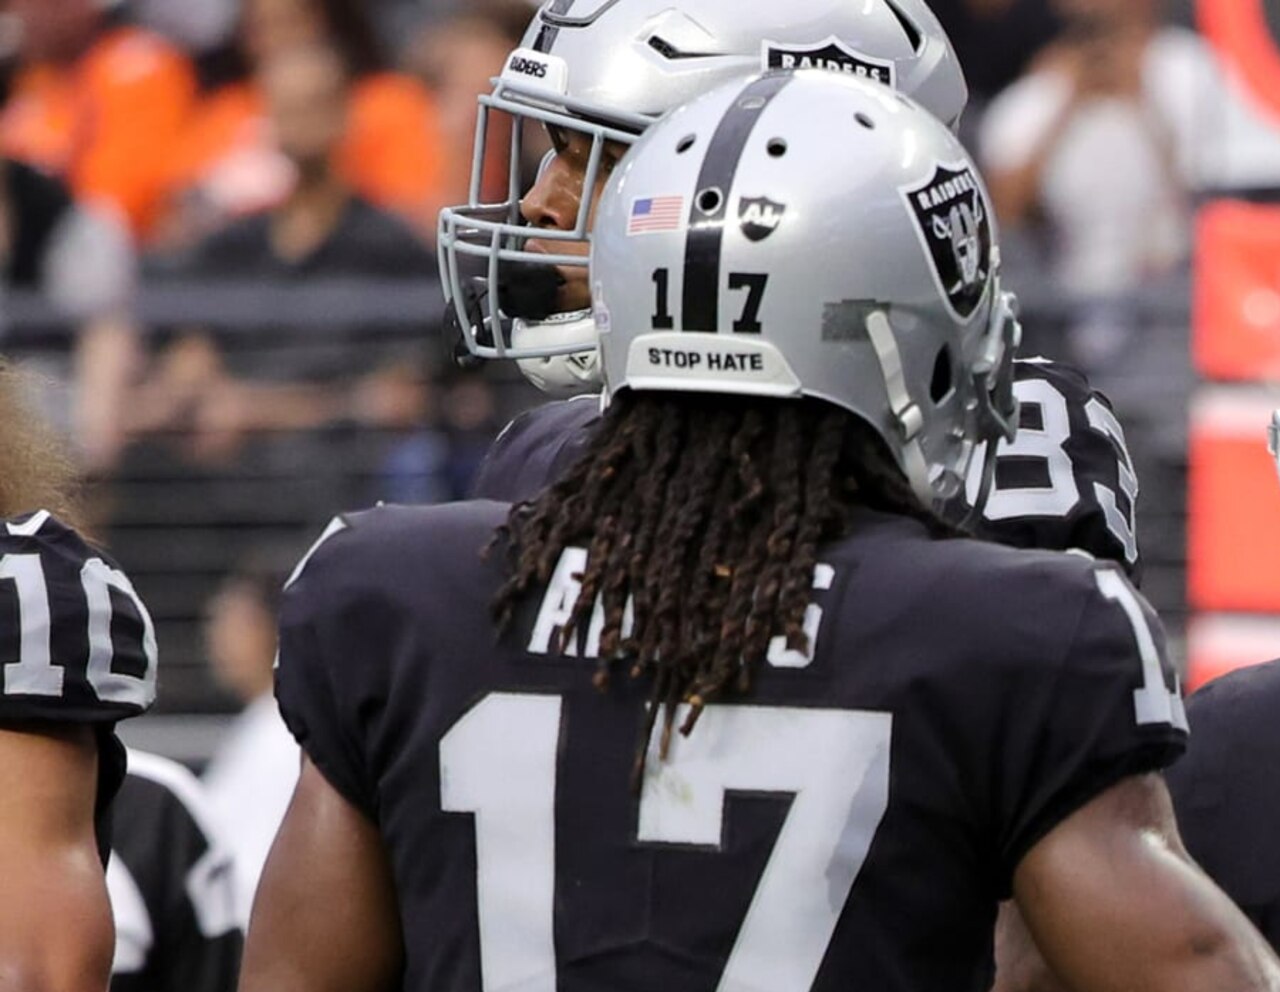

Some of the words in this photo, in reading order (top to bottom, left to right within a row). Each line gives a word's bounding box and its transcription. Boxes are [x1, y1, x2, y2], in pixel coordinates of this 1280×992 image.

[648, 347, 701, 369] STOP
[706, 353, 764, 372] HATE
[0, 553, 159, 709] 10
